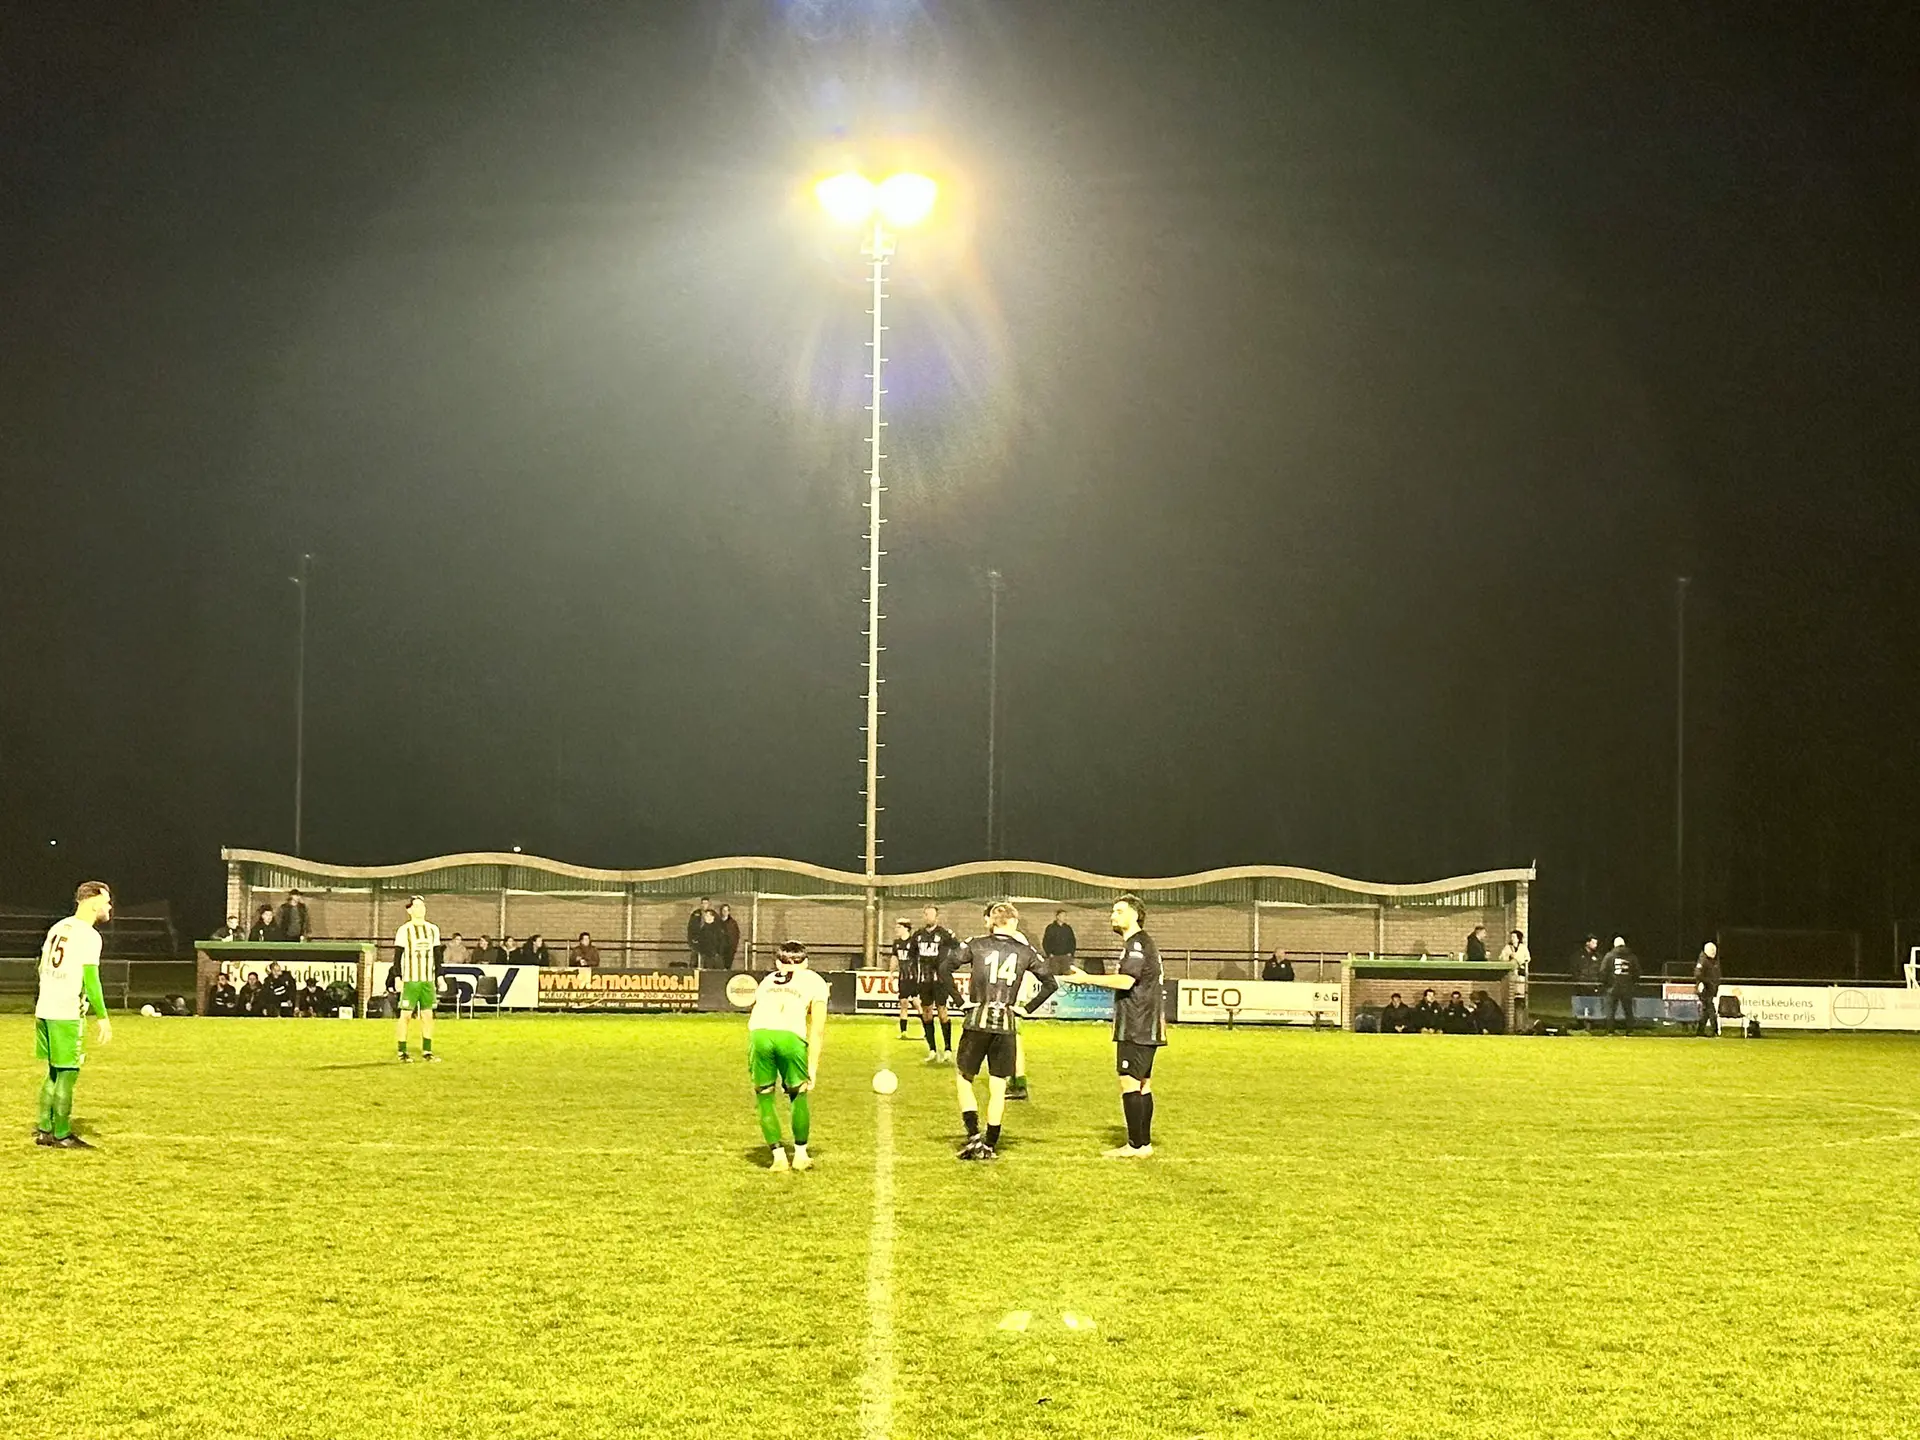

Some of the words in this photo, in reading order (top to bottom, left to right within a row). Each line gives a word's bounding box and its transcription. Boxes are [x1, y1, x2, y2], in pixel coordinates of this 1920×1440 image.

[48, 934, 68, 968] 15
[985, 950, 1017, 986] 14
[539, 970, 700, 991] www.arnoautos.nl
[1182, 988, 1241, 1006] TEO
[1740, 997, 1813, 1009] liteitskeukens
[1762, 1010, 1790, 1021] beste
[1793, 1010, 1816, 1023] prijs
